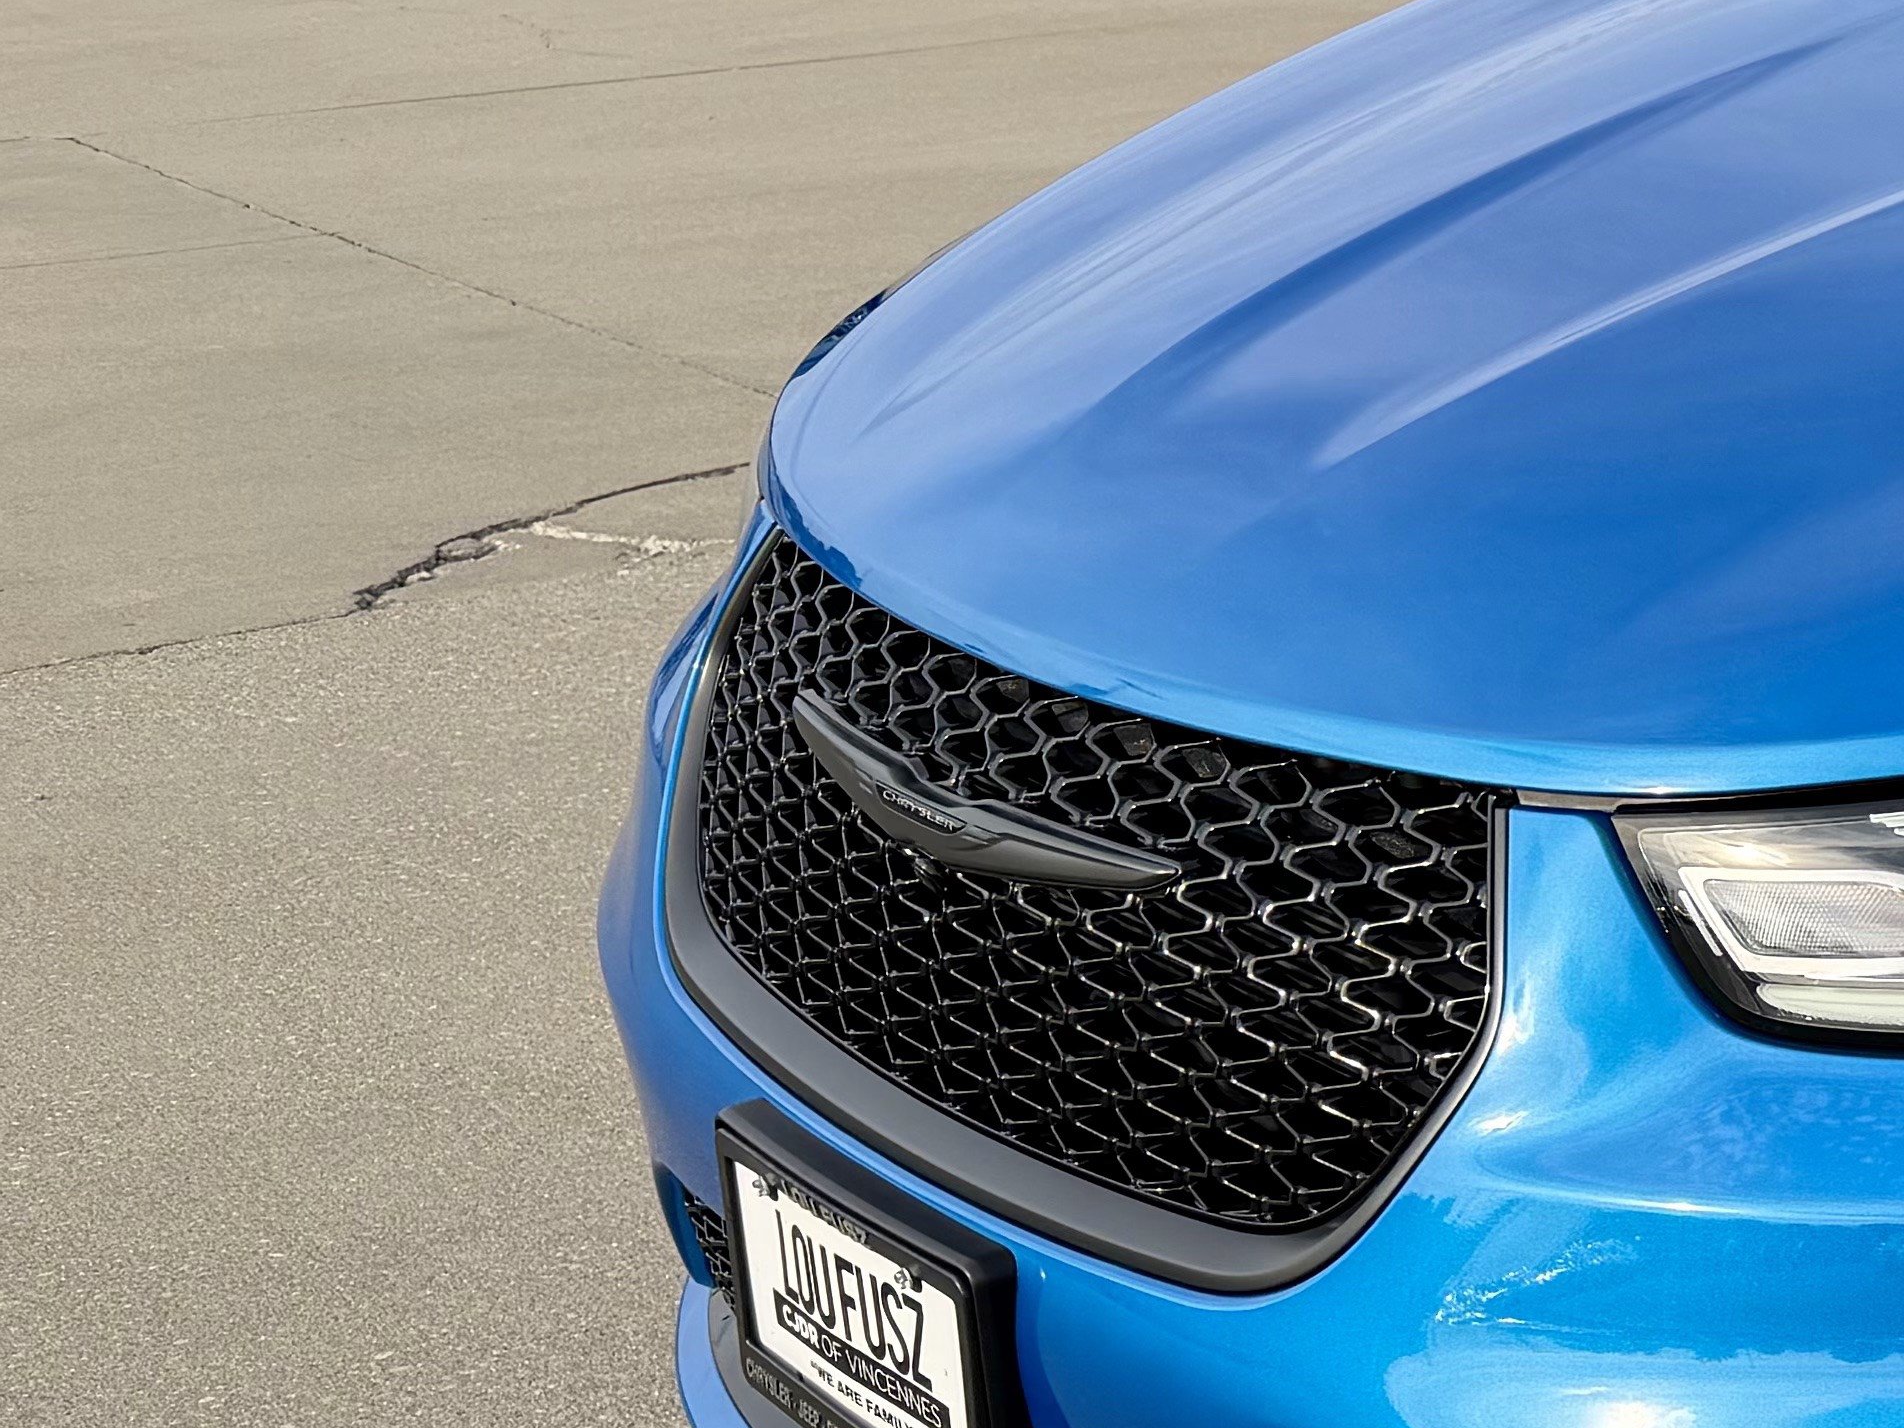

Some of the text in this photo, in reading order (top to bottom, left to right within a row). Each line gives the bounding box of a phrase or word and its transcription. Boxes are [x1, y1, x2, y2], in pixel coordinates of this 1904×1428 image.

[882, 789, 954, 832] CHRYSLER
[775, 1209, 933, 1393] LOU FUSZ
[746, 1358, 792, 1410] CHRYSLER
[798, 1398, 820, 1428] JEEP
[782, 1304, 943, 1428] CJDR OF VINCENNES
[837, 1378, 863, 1408] ARE
